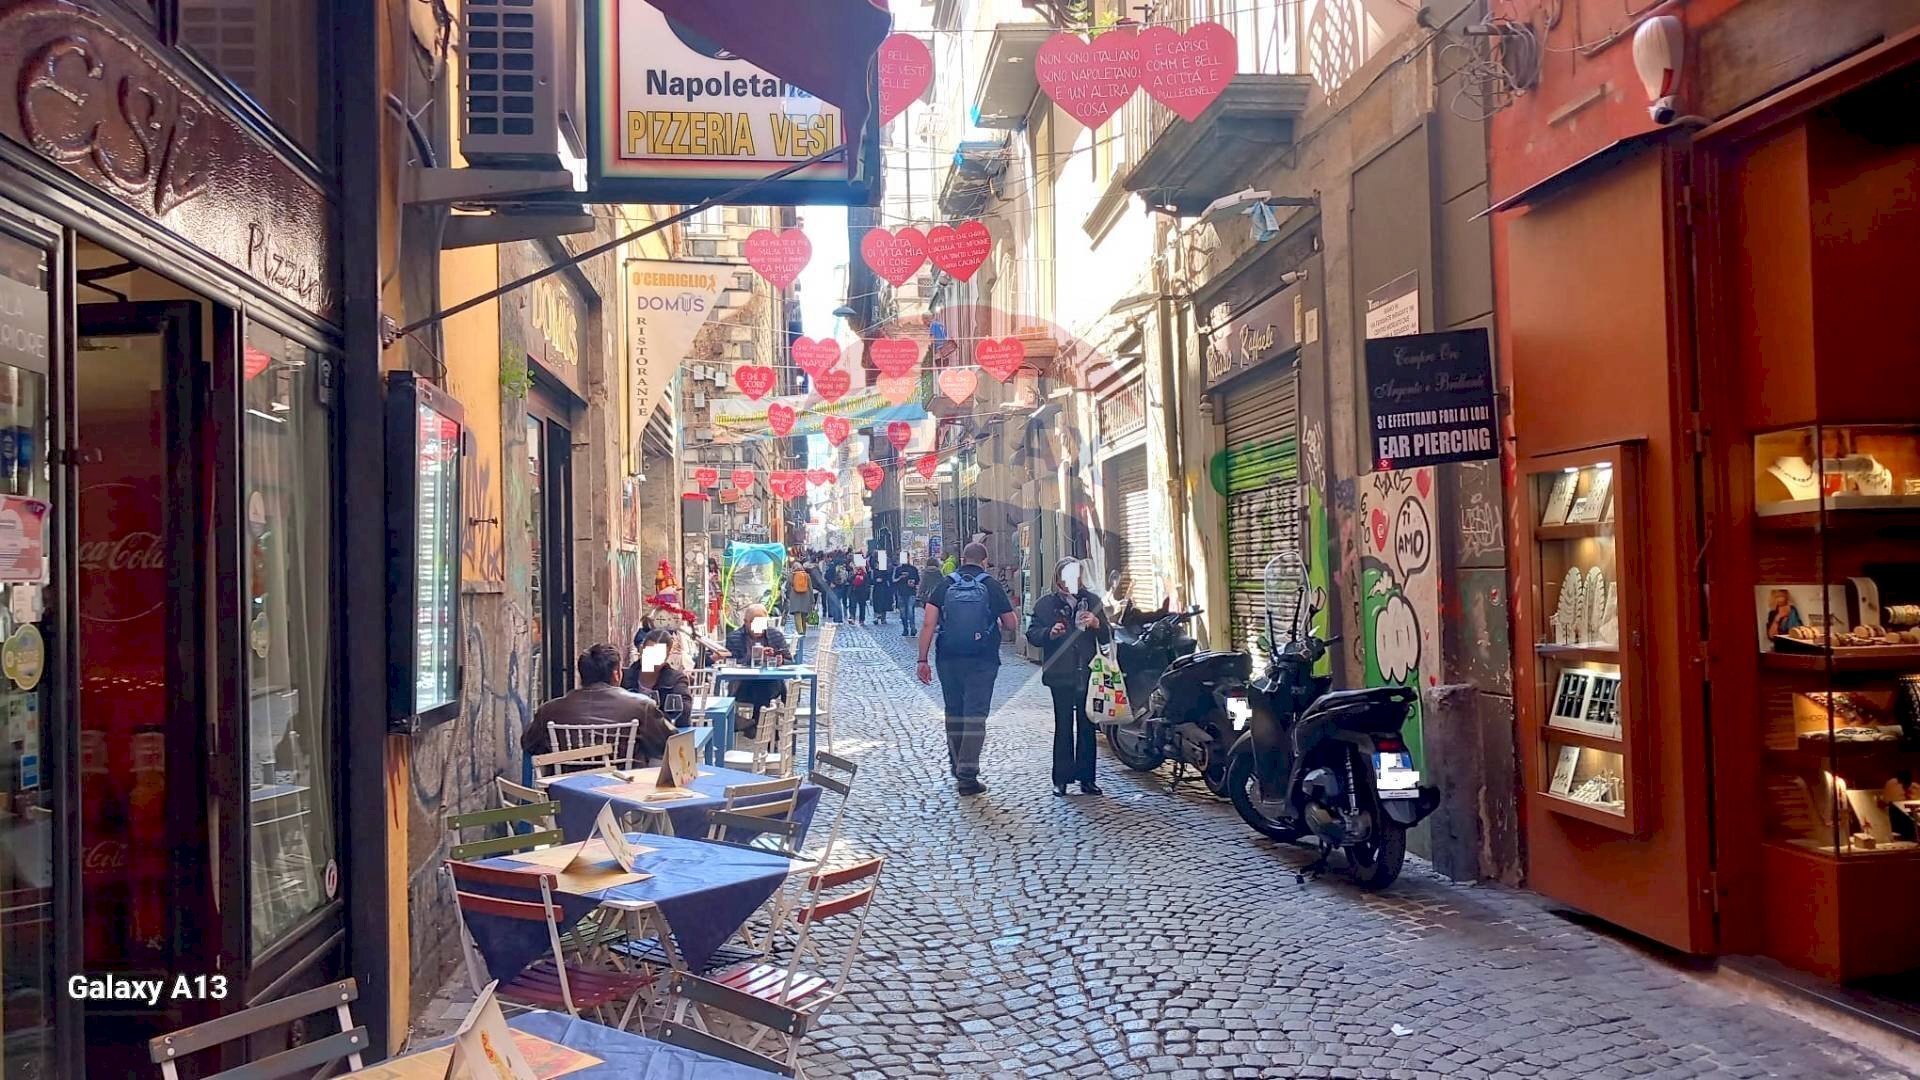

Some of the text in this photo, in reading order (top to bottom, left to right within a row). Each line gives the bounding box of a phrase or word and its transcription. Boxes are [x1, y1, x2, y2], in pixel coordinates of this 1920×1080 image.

[1093, 48, 1140, 64] ITALIANO
[627, 110, 834, 157] PIZZERIA VESI
[637, 293, 705, 315] DOMUS
[636, 317, 649, 417] RISTORANTE
[1377, 415, 1386, 430] SI
[1388, 411, 1437, 429] EFFETTUANO
[1460, 407, 1469, 422] AI
[1378, 427, 1491, 459] EAR PIERCING
[79, 532, 166, 570] ca-Cola
[1398, 530, 1424, 558] AMO
